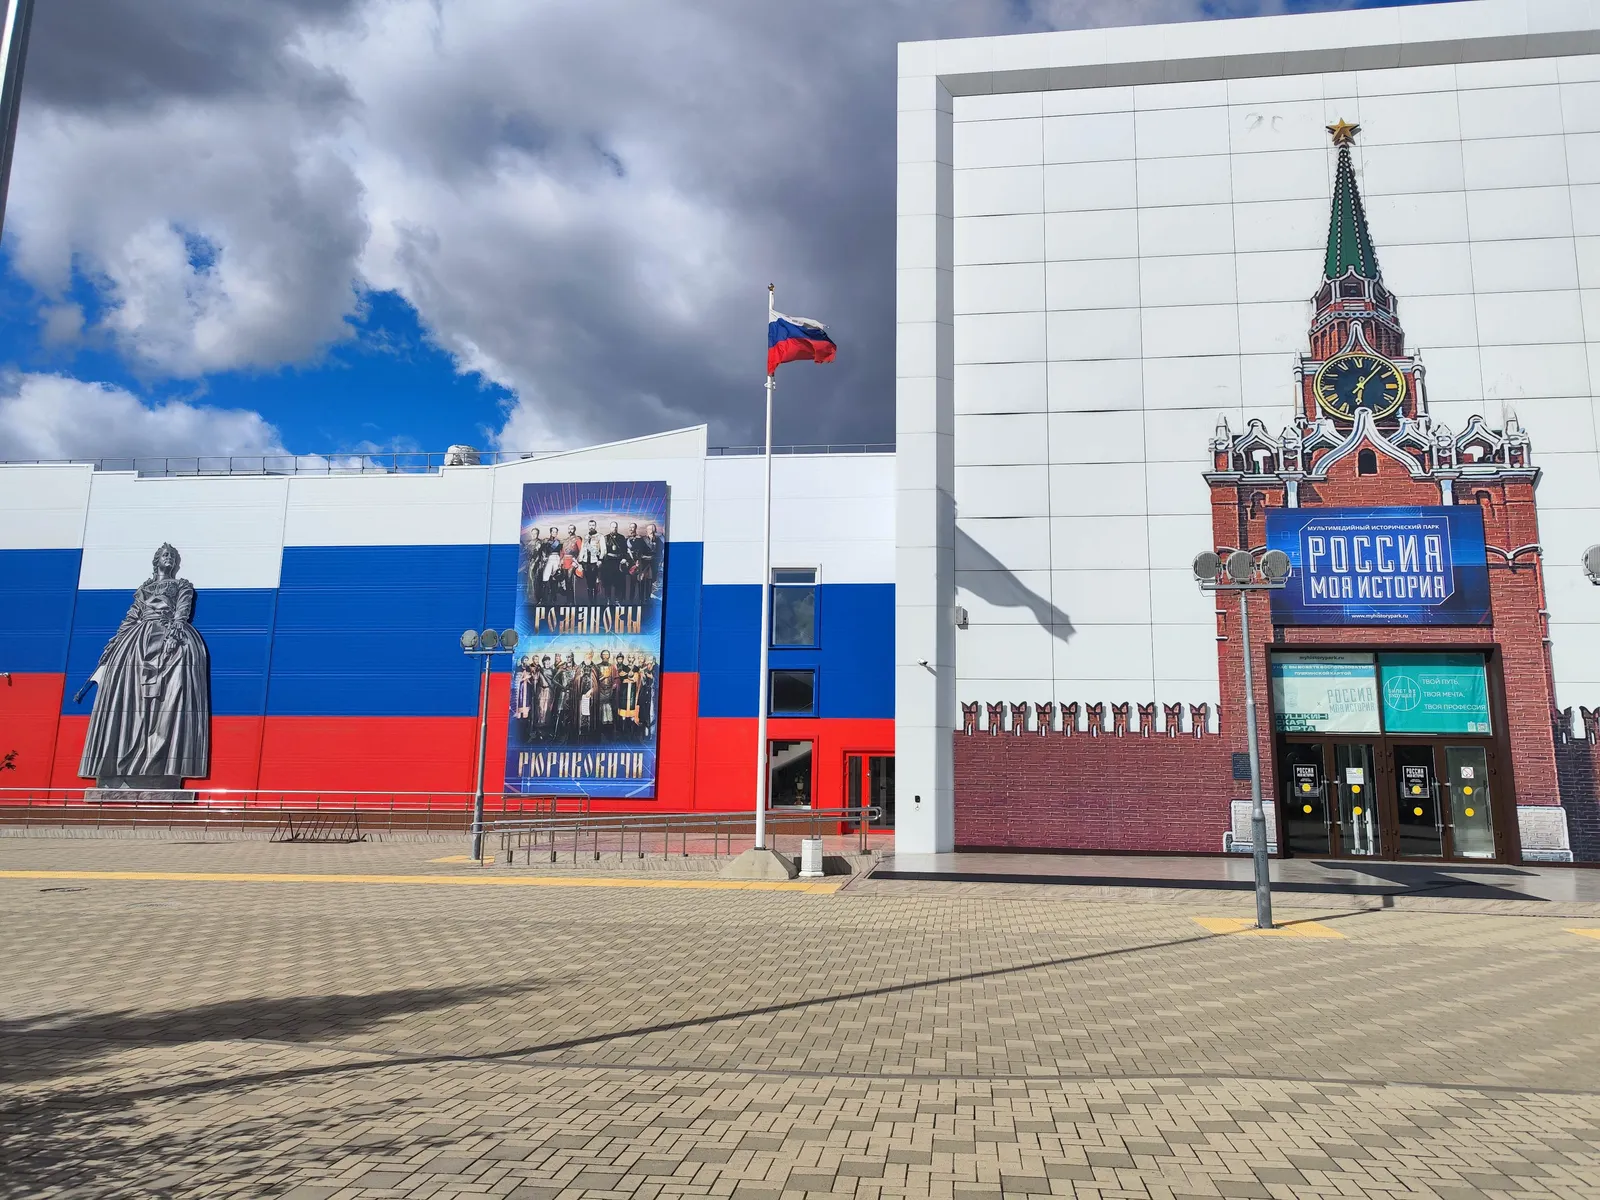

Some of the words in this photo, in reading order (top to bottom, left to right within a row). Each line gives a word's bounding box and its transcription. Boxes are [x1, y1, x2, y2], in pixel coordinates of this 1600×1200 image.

[1308, 535, 1444, 573] РОССИЯ
[1310, 576, 1353, 599] МОЯ
[1357, 575, 1446, 598] ИСТОРИЯ
[534, 605, 642, 634] РОМАНОВЫ
[1327, 687, 1373, 703] РОССИЯ
[1329, 703, 1345, 713] МОЯ
[1345, 702, 1376, 712] ИСТОРИЯ
[518, 752, 644, 778] РЮРИКОВИЧИ
